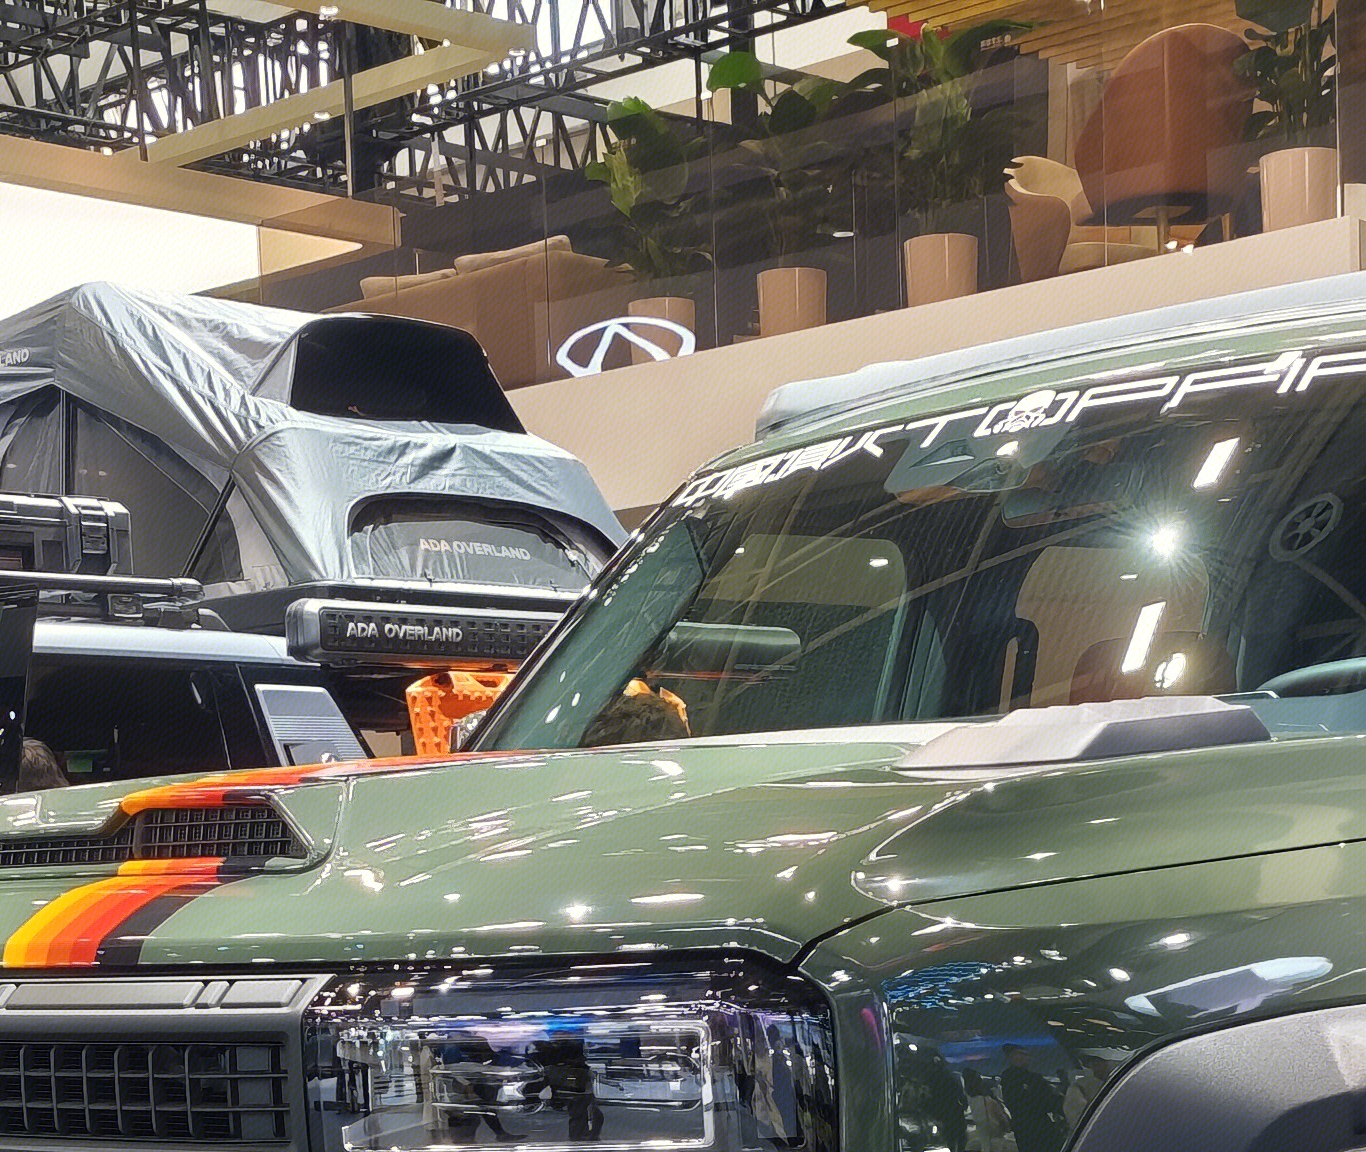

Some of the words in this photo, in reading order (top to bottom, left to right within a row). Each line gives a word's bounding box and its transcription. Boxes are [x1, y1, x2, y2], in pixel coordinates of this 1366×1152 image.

[419, 538, 452, 552] ADA
[453, 540, 531, 561] OVERLAND
[346, 622, 379, 638] ADA
[384, 623, 463, 642] OVERLAND
